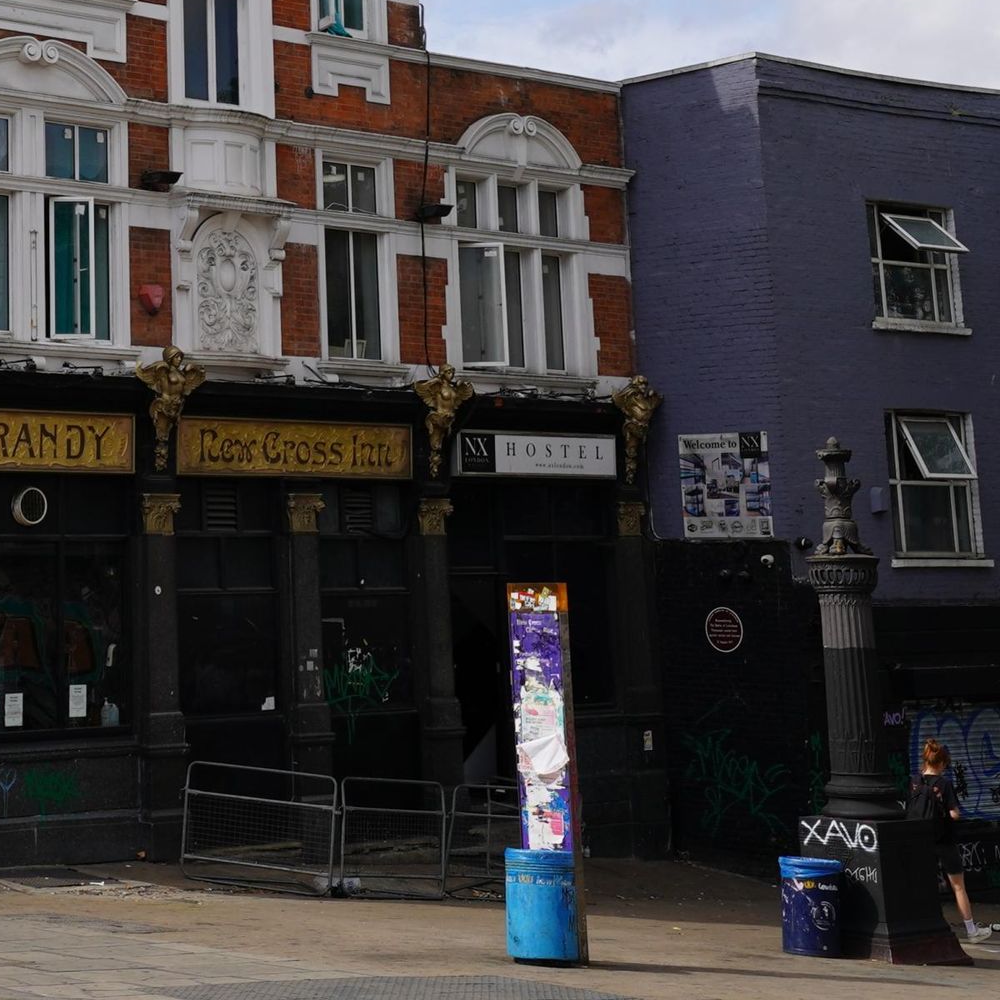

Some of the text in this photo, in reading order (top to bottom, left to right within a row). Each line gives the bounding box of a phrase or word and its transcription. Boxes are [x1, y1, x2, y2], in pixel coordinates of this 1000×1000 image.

[262, 431, 344, 466] Cross
[464, 437, 489, 456] NX
[506, 442, 604, 461] HOSTEL
[683, 440, 726, 450] Welcome
[728, 440, 737, 449] to
[800, 819, 878, 852] XAVO
